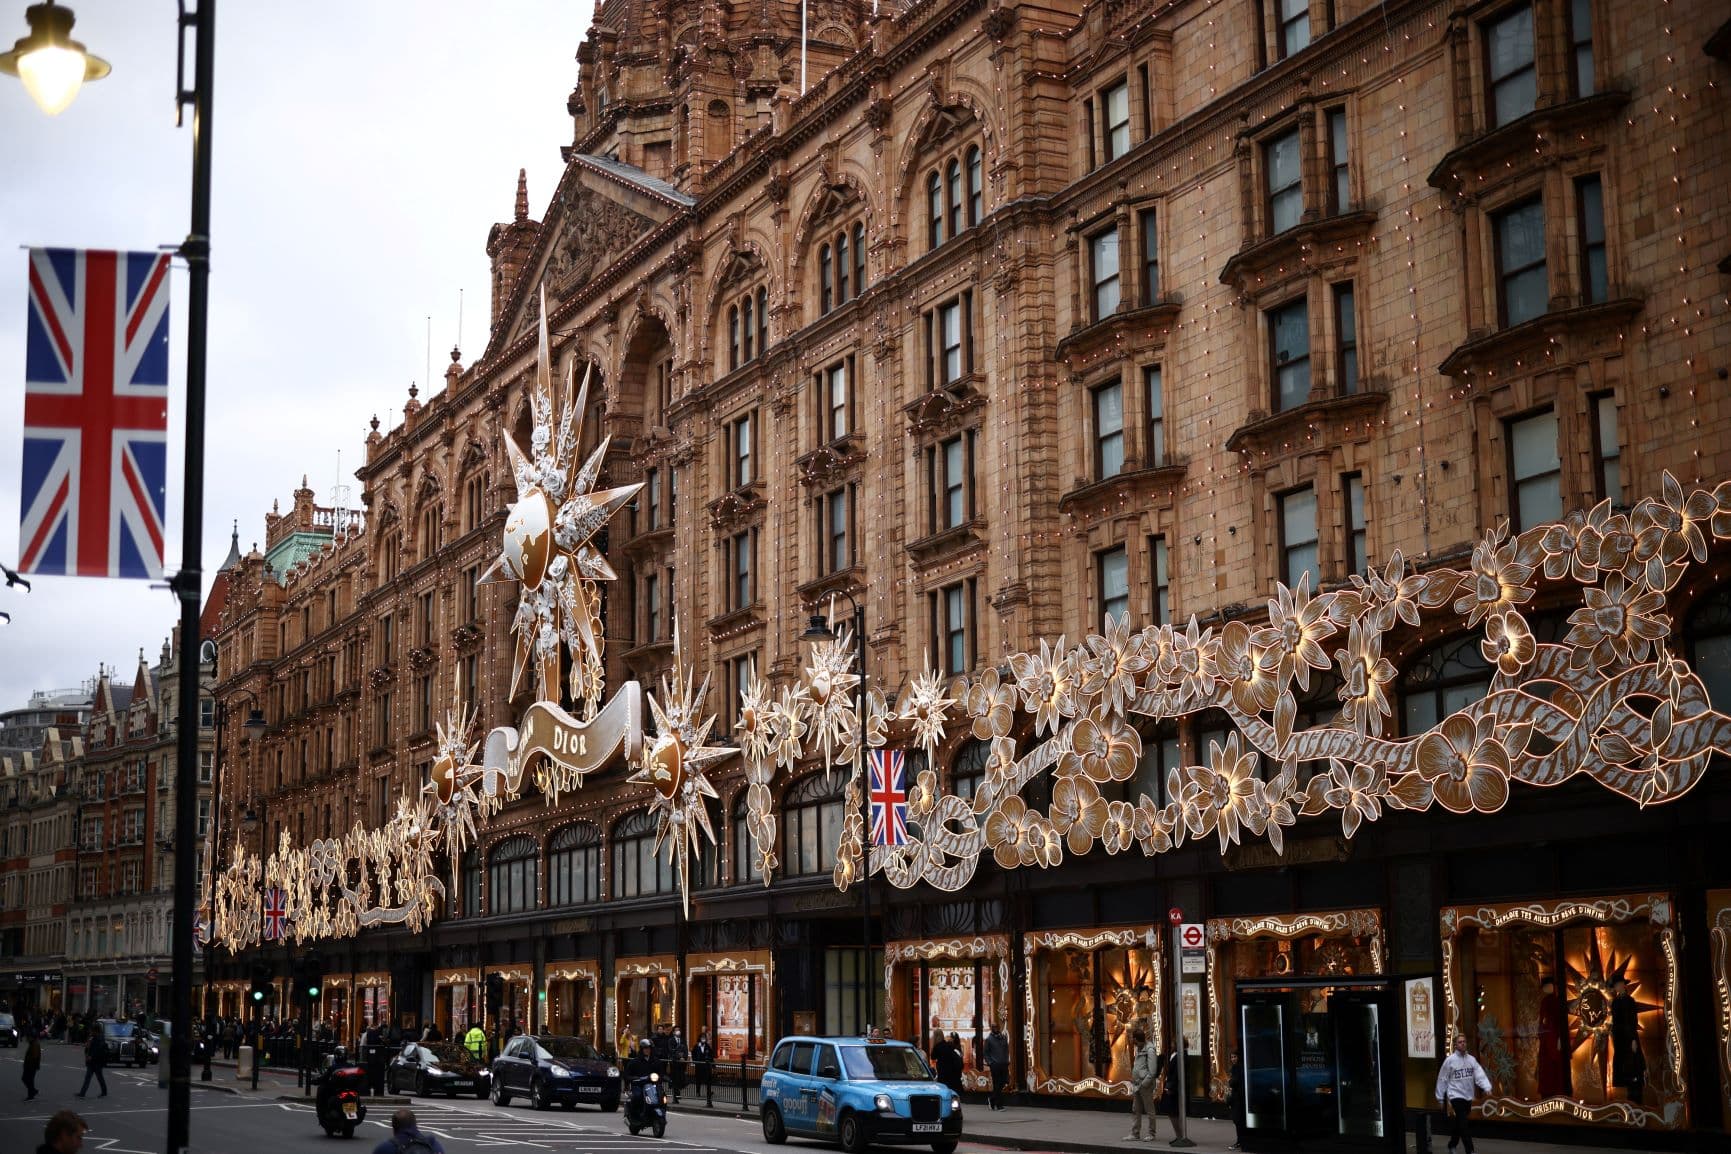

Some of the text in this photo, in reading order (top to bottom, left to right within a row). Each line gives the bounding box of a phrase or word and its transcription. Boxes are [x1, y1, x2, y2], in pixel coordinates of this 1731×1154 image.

[553, 725, 587, 756] DIOR
[1170, 912, 1181, 920] KA
[1521, 911, 1531, 920] TES
[1552, 914, 1560, 923] ET
[1717, 978, 1731, 1043] L'ATELIER
[783, 1094, 808, 1116] gopuff
[1529, 1101, 1593, 1121] CHRISTIAN DIOR
